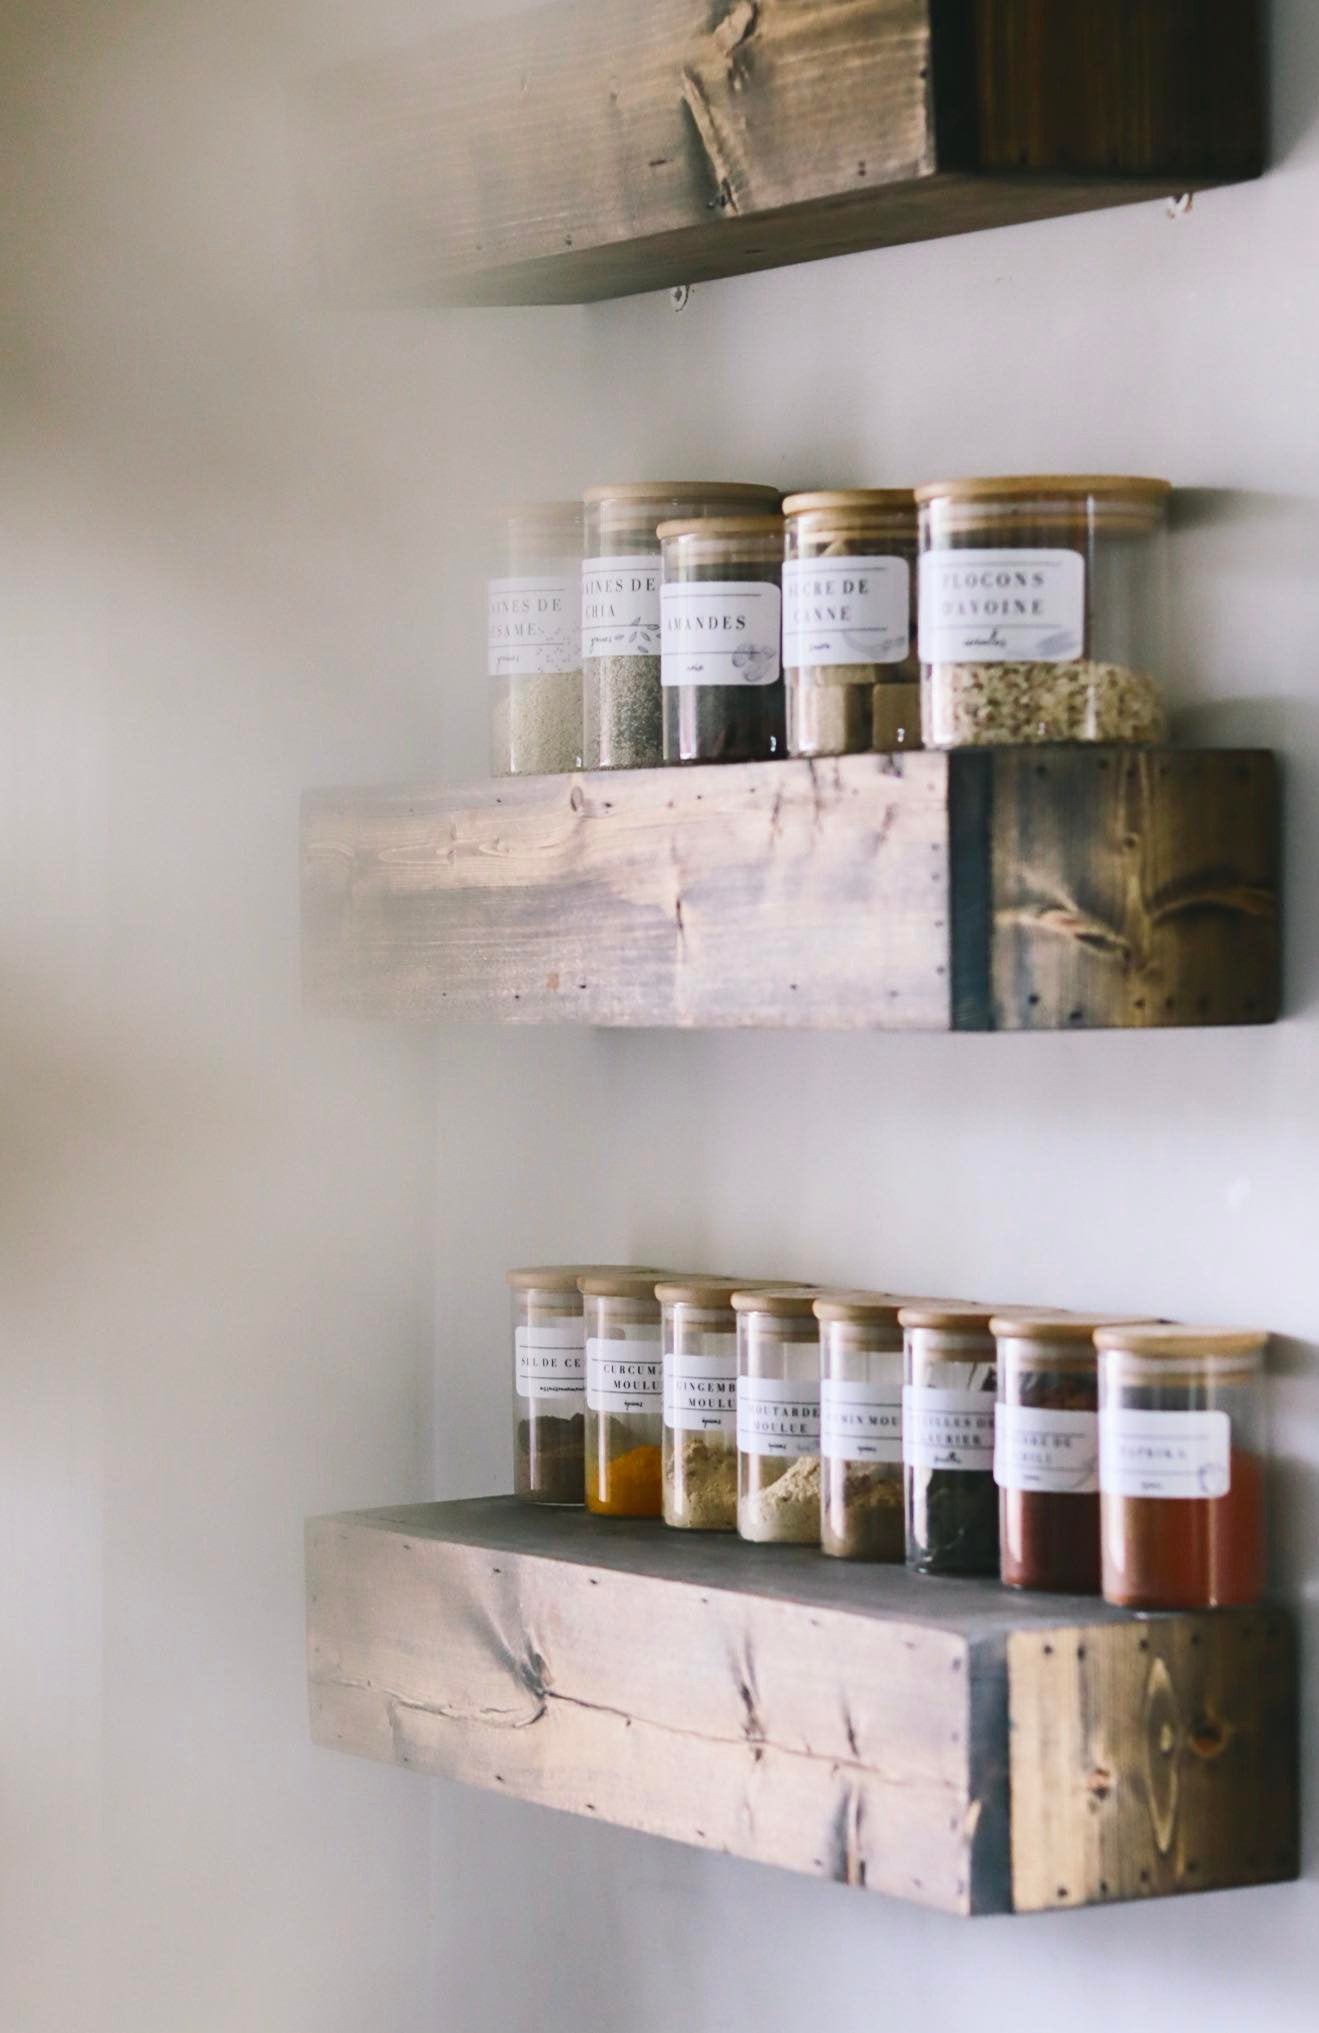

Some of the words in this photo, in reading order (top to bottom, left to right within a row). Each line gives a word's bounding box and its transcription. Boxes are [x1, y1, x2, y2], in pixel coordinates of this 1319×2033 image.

[631, 577, 656, 592] DE
[842, 578, 869, 595] DE
[943, 570, 1045, 589] FLOCONS
[537, 597, 563, 612] DE
[585, 603, 615, 618] CHIA
[667, 615, 746, 631] AMANDES
[542, 1358, 558, 1368] DE
[614, 1380, 659, 1390] MOULU
